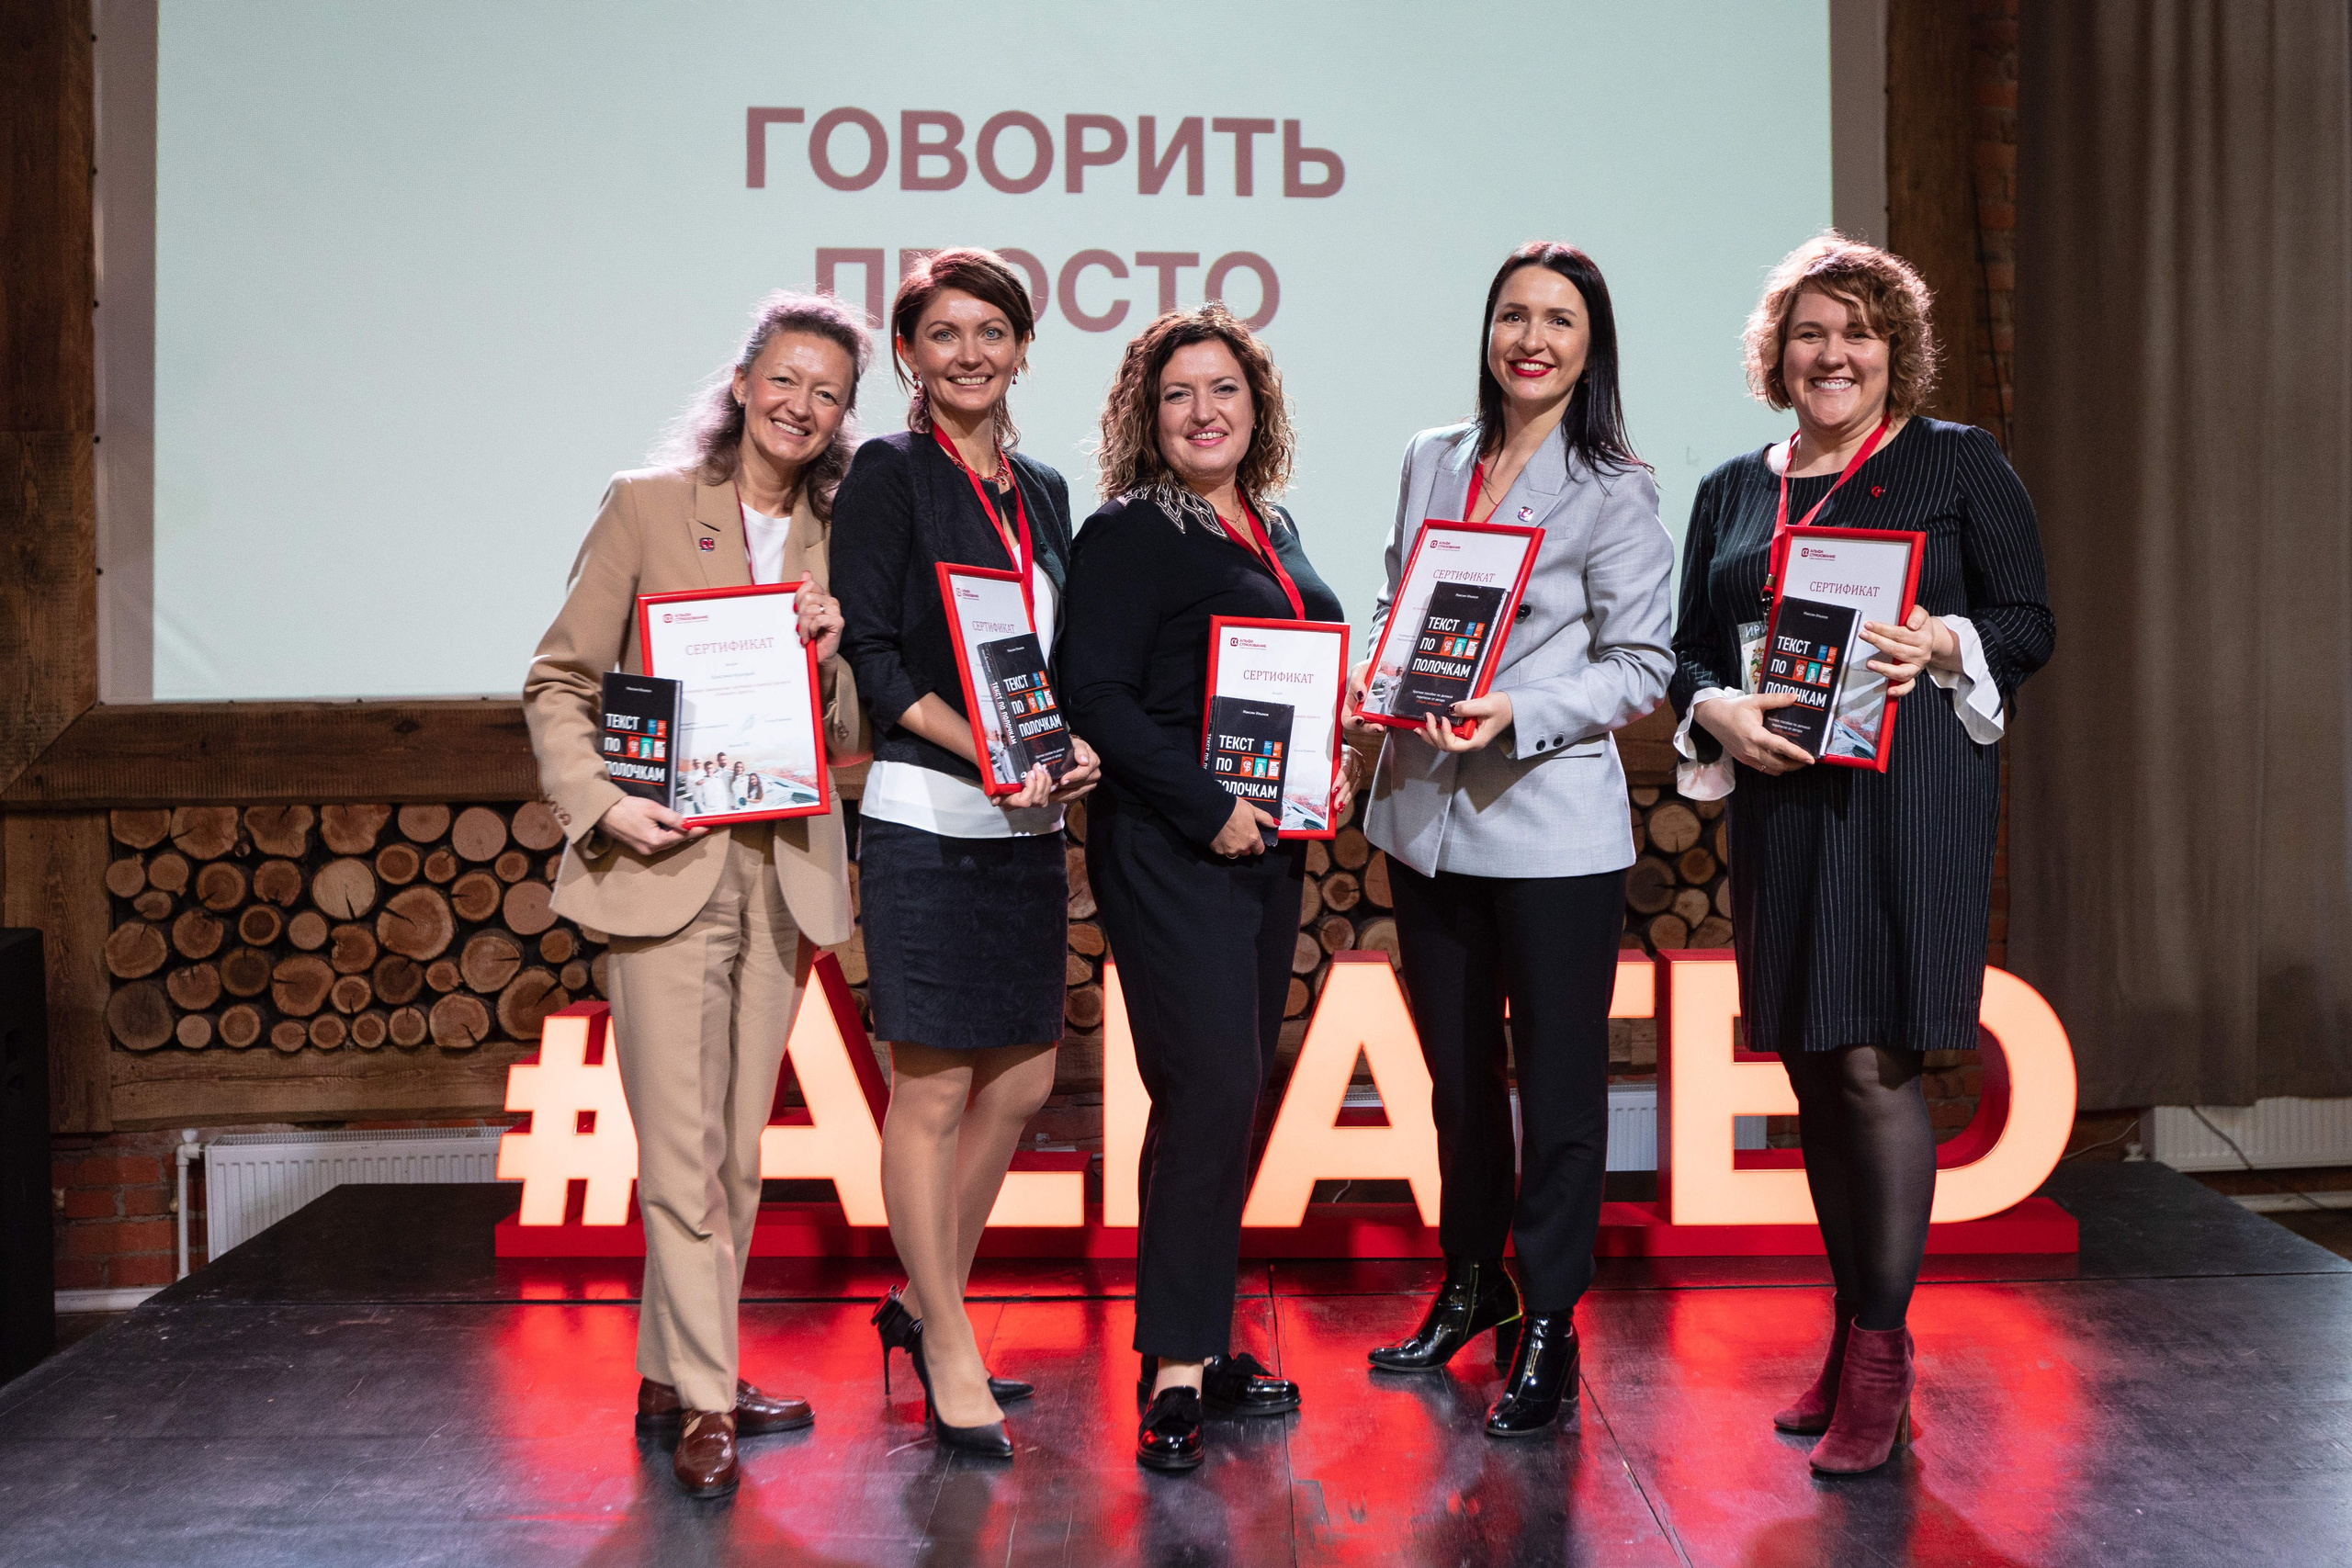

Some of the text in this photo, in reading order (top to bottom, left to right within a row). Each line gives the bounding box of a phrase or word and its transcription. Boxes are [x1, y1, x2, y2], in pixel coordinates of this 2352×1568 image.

[746, 107, 1345, 197] ГОВОРИТЬ
[815, 247, 1280, 333] ПСТО
[1433, 570, 1496, 582] СЕРТИФИКАТ
[1810, 581, 1880, 597] СЕРТИФИКАТ
[972, 621, 1014, 634] СЕРТИФИКАТ
[1429, 616, 1460, 631] ТЕКСТ
[685, 637, 775, 655] СЕРТИФИКАТ
[1419, 637, 1435, 650] ПО
[1778, 636, 1811, 654] ТЕКСТ
[1412, 659, 1471, 678] ПОЛОЧКАМ
[1770, 659, 1786, 673] ПО
[1003, 674, 1029, 692] ТЕКСТ
[1243, 670, 1314, 683] СЕРТИФИКАТ
[992, 682, 1017, 745] ТЕКСТ ПО ПОЛОЧКАМ
[1011, 700, 1024, 715] ПО
[605, 713, 640, 730] ТЕКСТ
[1018, 714, 1062, 737] ПОЛОЧКАМ
[605, 737, 621, 751] ПО
[1219, 735, 1254, 751] ТЕКСТ
[1216, 757, 1232, 772] ПО
[1215, 779, 1278, 799] ОЛОЧКАМ
